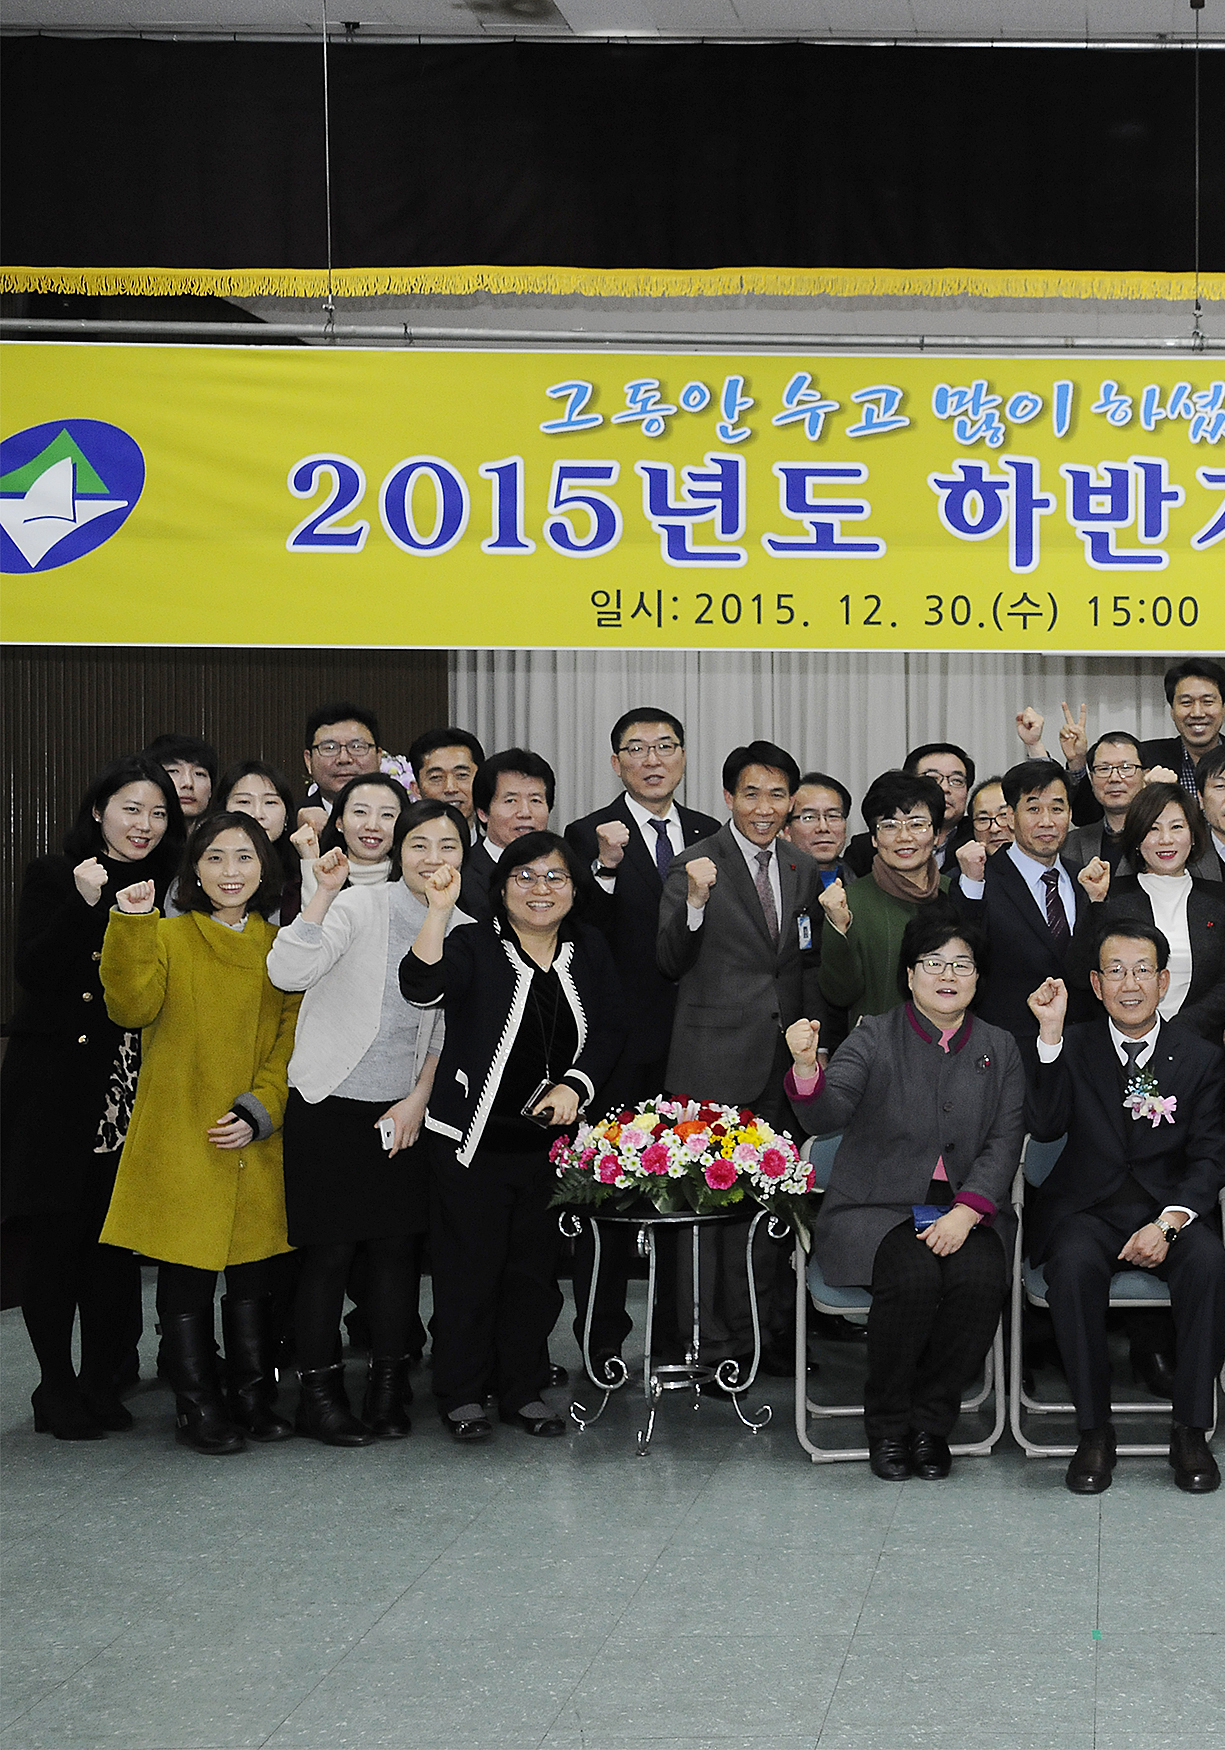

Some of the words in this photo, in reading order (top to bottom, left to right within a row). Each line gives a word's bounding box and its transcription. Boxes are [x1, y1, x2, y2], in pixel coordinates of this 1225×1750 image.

[537, 374, 754, 444] 그동안
[772, 371, 910, 440] 수고
[931, 379, 1073, 447] 많이
[289, 454, 884, 564] 2015년도
[590, 588, 678, 627] 일시:
[694, 591, 809, 627] 2015.
[838, 593, 897, 628] 12.
[924, 590, 1058, 632] 30.(수)
[1087, 594, 1199, 627] 15:00
